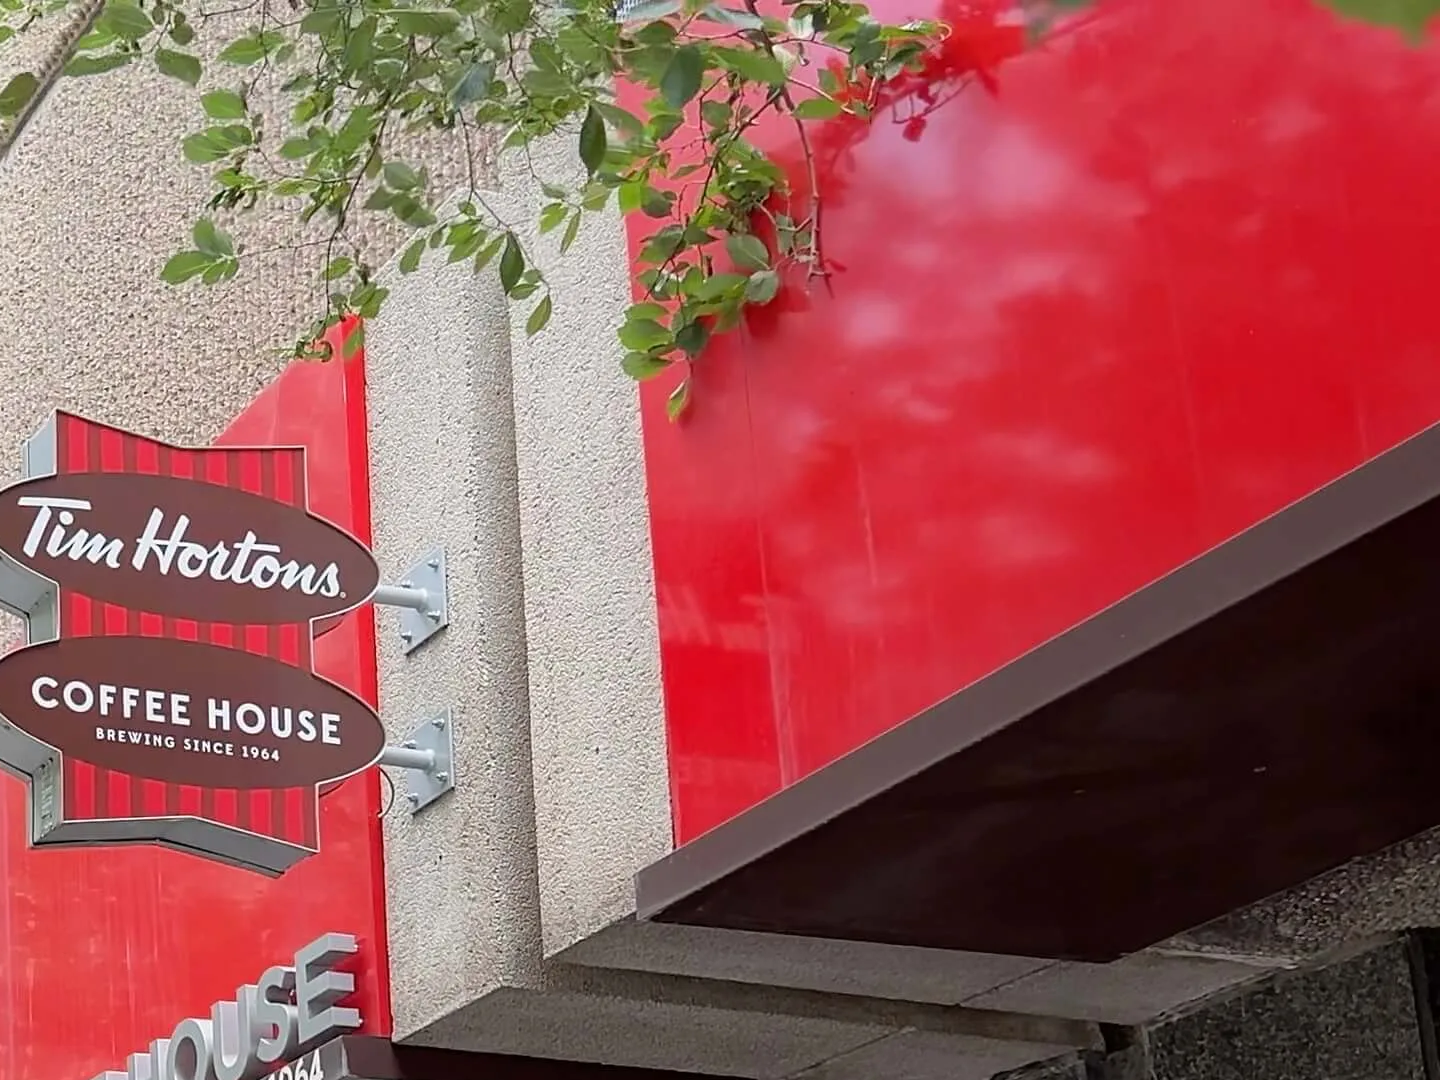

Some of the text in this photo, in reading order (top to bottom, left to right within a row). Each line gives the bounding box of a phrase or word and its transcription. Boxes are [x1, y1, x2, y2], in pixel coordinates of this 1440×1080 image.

[18, 496, 340, 598] Tim Hortons
[31, 676, 341, 745] COFFEE HOUSE
[95, 727, 280, 762] BREWING SINCE 1964
